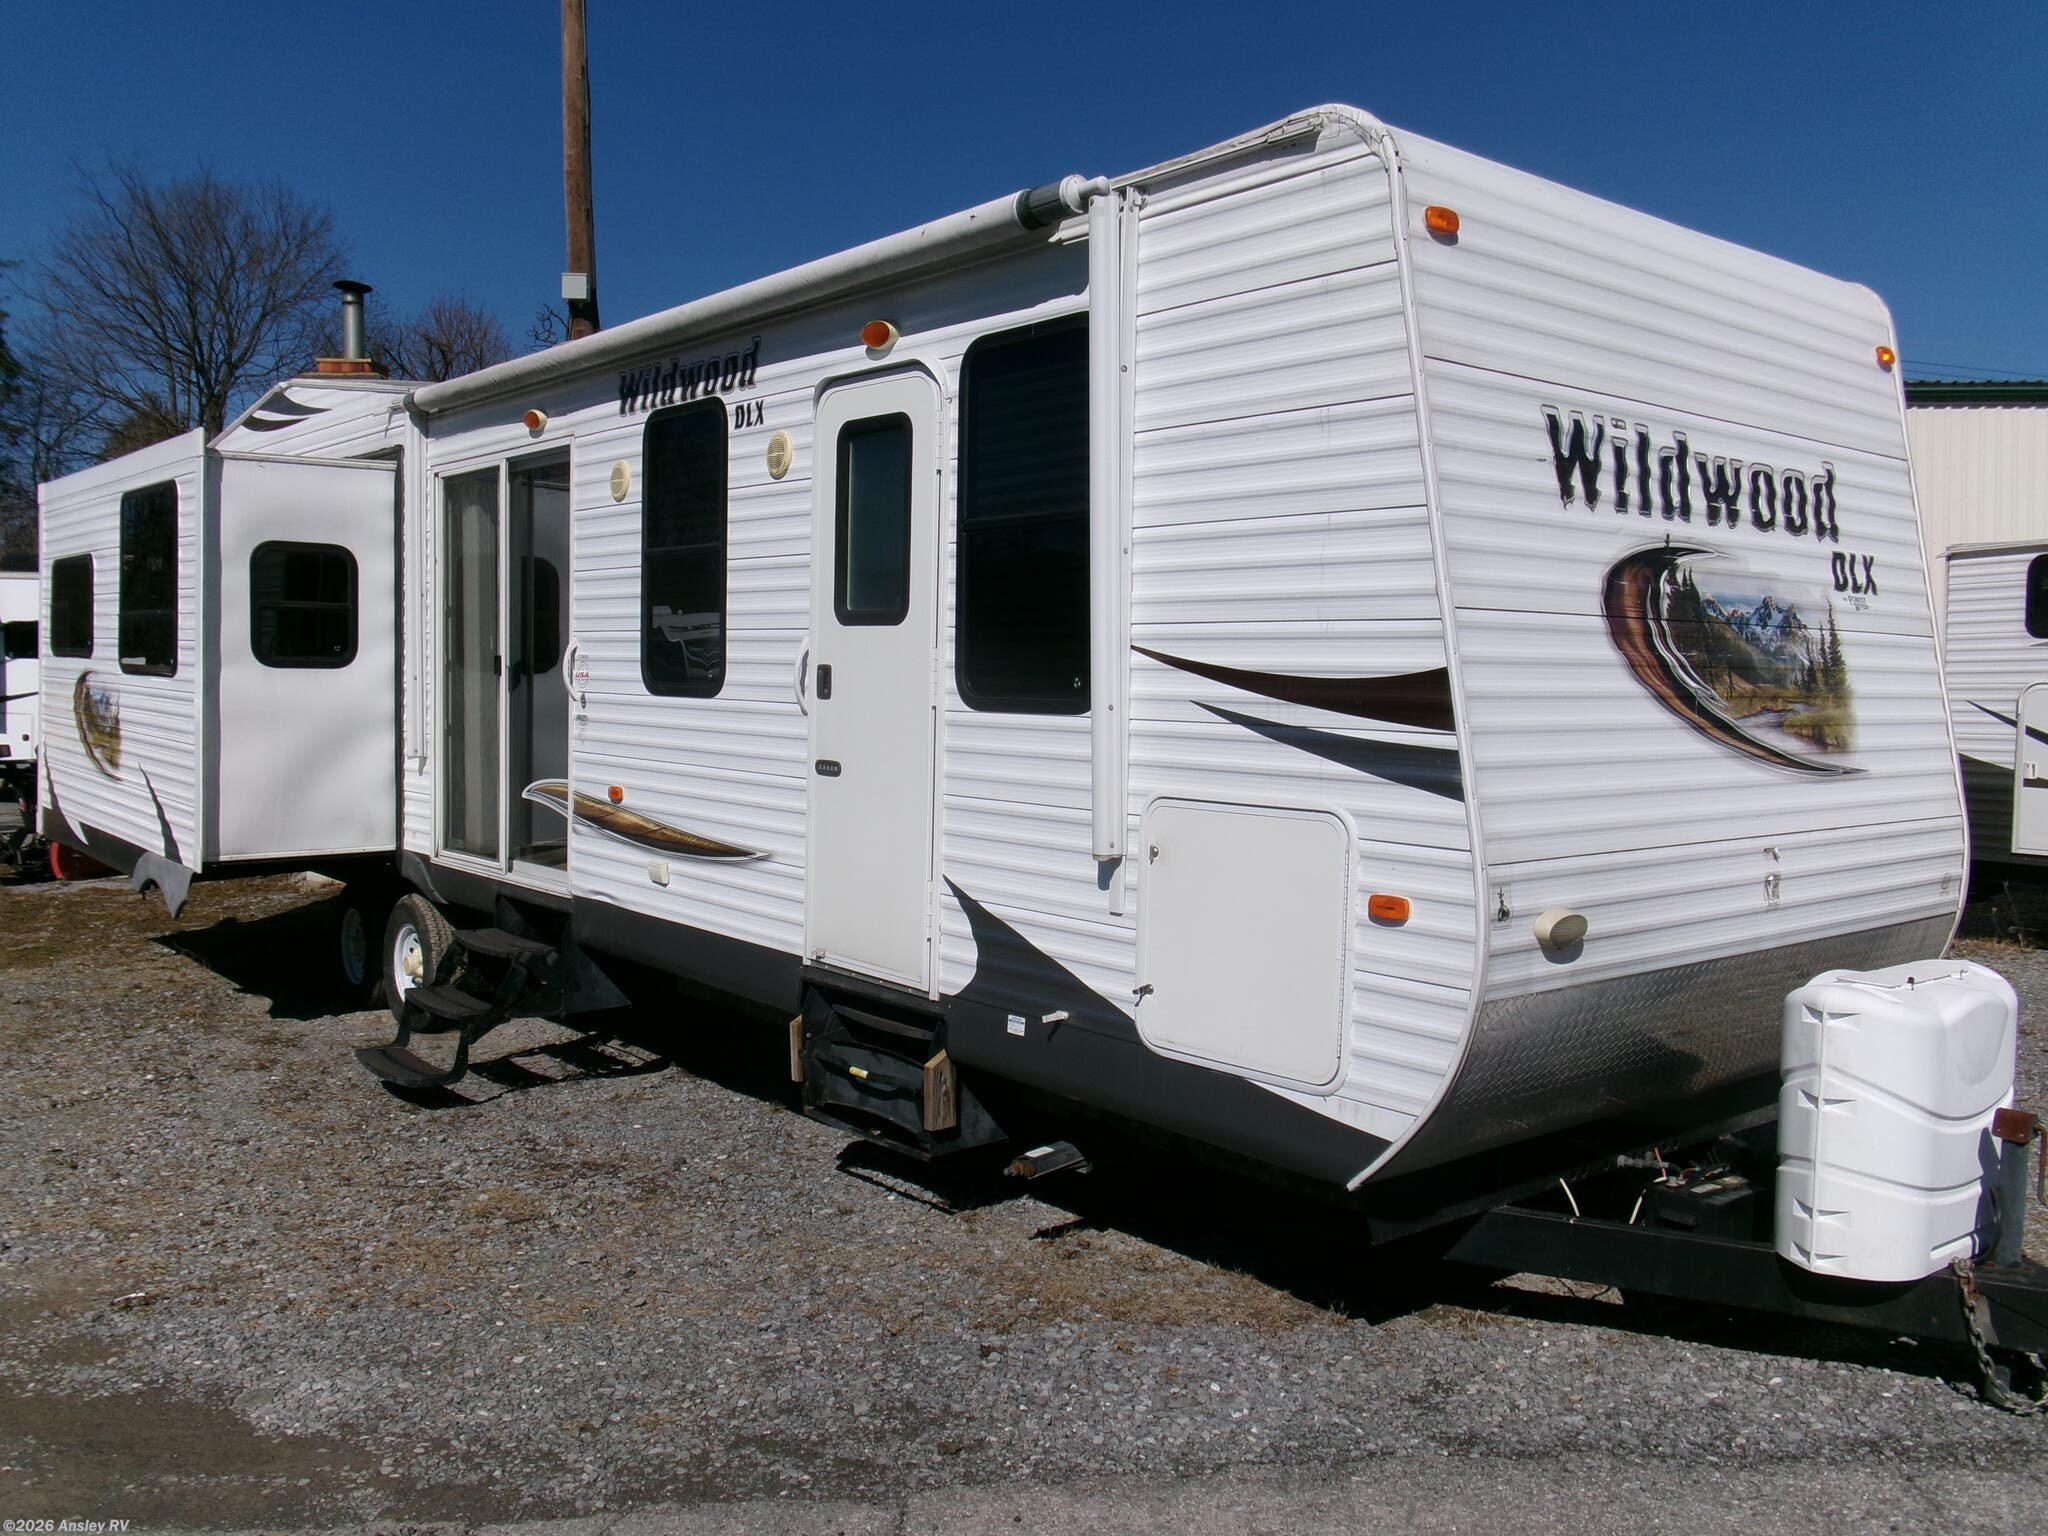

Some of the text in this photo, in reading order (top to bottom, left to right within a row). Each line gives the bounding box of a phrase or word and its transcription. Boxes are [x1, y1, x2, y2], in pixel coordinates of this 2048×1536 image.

[618, 335, 762, 417] Wildwood
[734, 400, 765, 430] DLX
[1540, 404, 1839, 543] Wildwood
[1832, 551, 1878, 596] DLX
